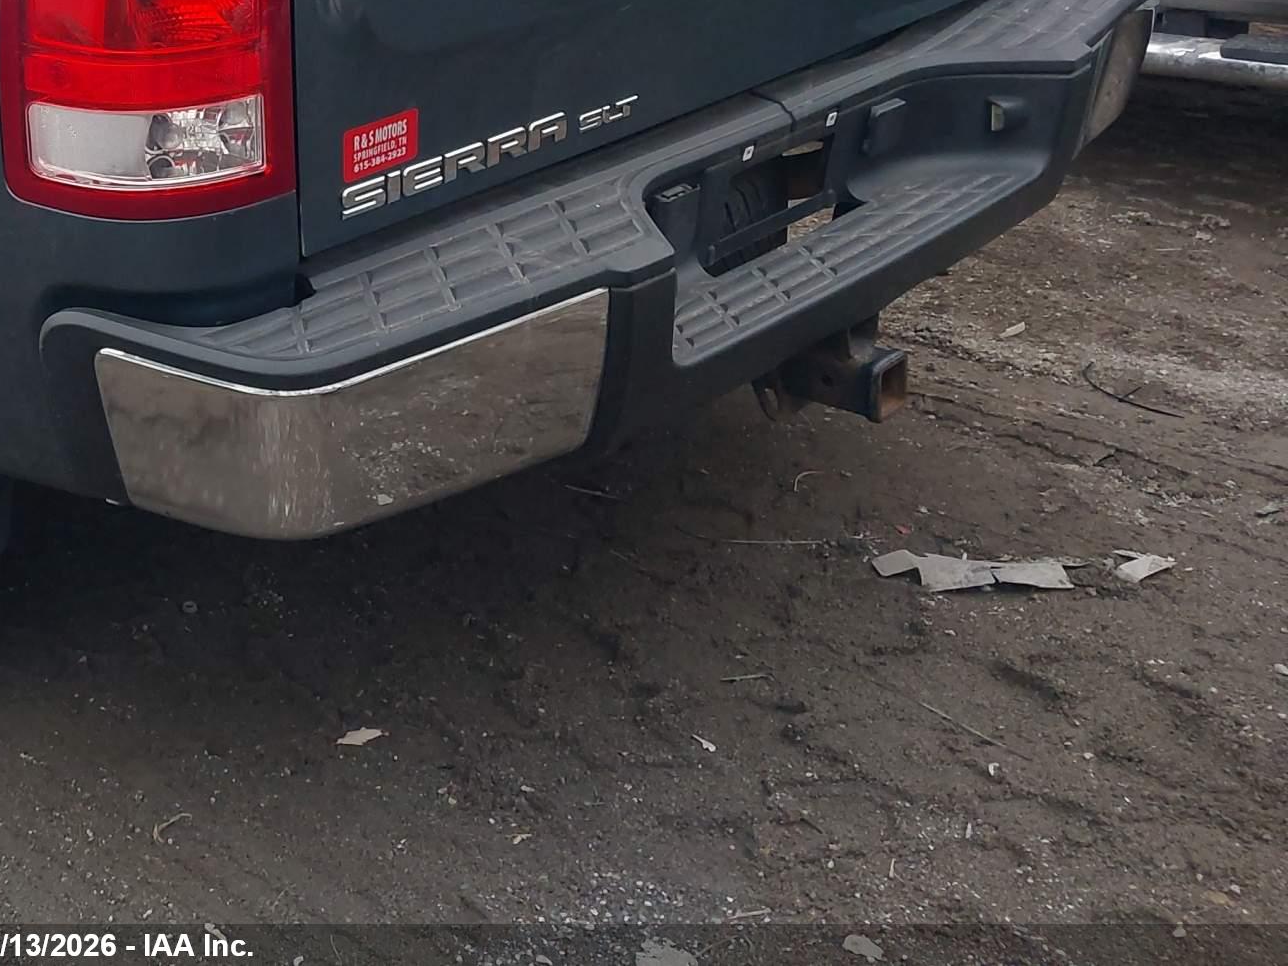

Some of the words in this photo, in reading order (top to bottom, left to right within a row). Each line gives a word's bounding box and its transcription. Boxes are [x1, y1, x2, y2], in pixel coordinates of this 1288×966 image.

[375, 118, 408, 144] MOTORS
[398, 135, 408, 147] TN
[341, 111, 567, 220] SIERRA
[578, 94, 639, 133] SLT
[353, 146, 407, 173] 615-384-2923
